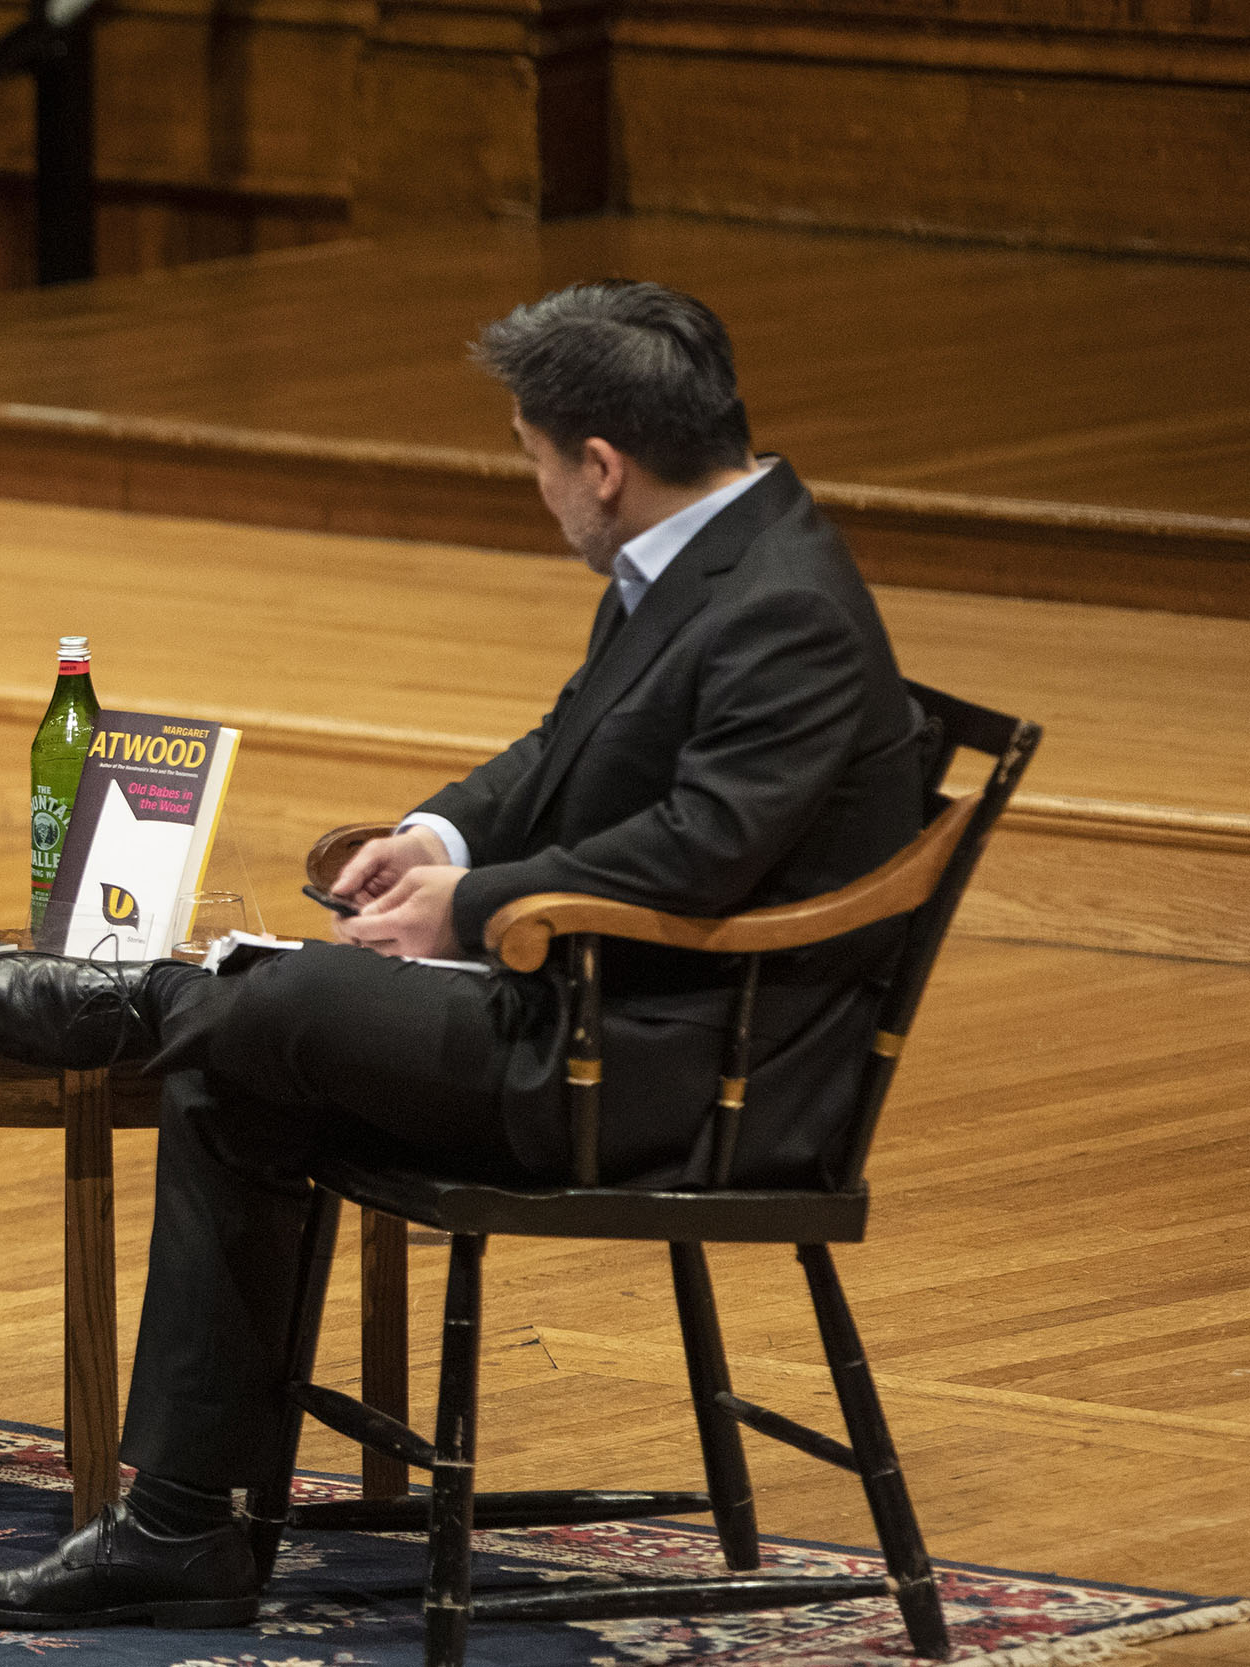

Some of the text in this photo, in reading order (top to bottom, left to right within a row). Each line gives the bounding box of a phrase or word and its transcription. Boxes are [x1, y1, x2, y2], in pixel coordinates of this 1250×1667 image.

[162, 725, 210, 738] MARGARET
[88, 731, 207, 768] ATWOOD
[37, 785, 52, 795] THE
[128, 782, 193, 800] Old Babes in
[140, 798, 190, 814] the Wood
[31, 849, 61, 868] ALLE
[127, 936, 145, 944] Stories
